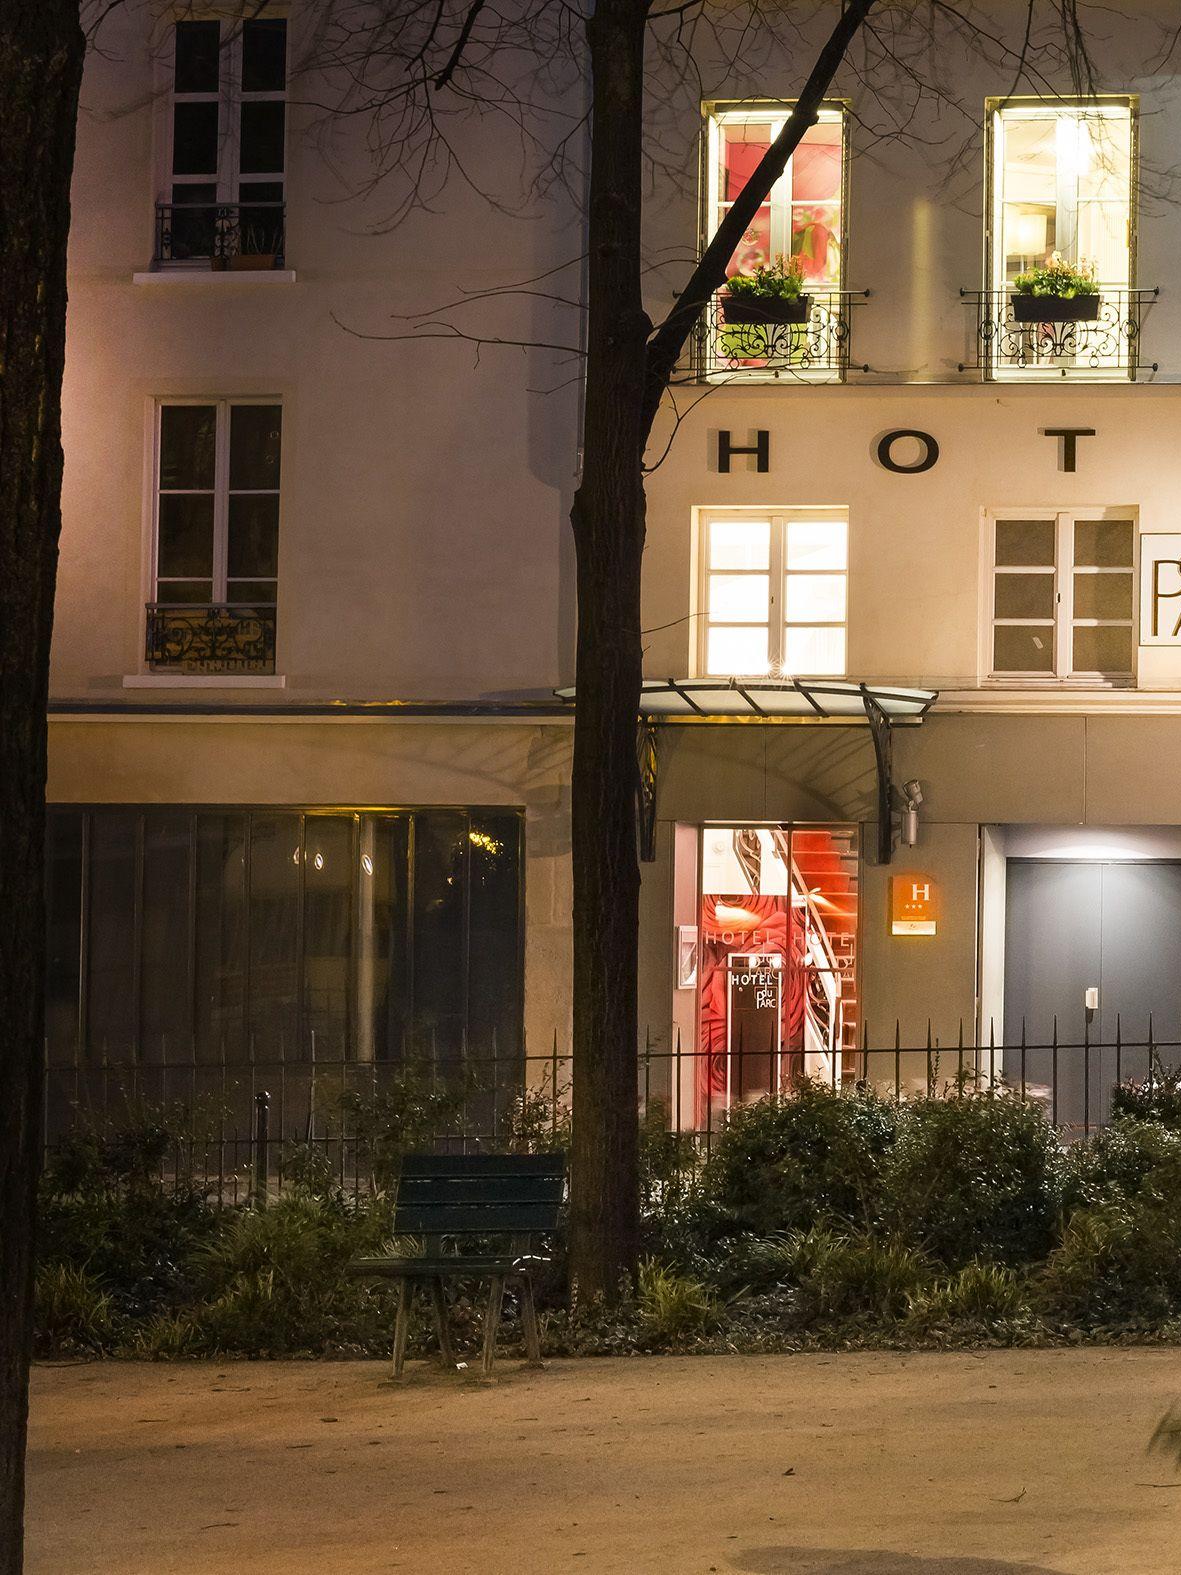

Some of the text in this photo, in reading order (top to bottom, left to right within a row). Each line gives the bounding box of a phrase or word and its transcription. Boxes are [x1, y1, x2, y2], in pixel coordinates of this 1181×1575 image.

[912, 883, 930, 901] H
[705, 930, 775, 945] HOTEL
[793, 931, 850, 947] HOTE
[731, 974, 773, 986] HOTEL
